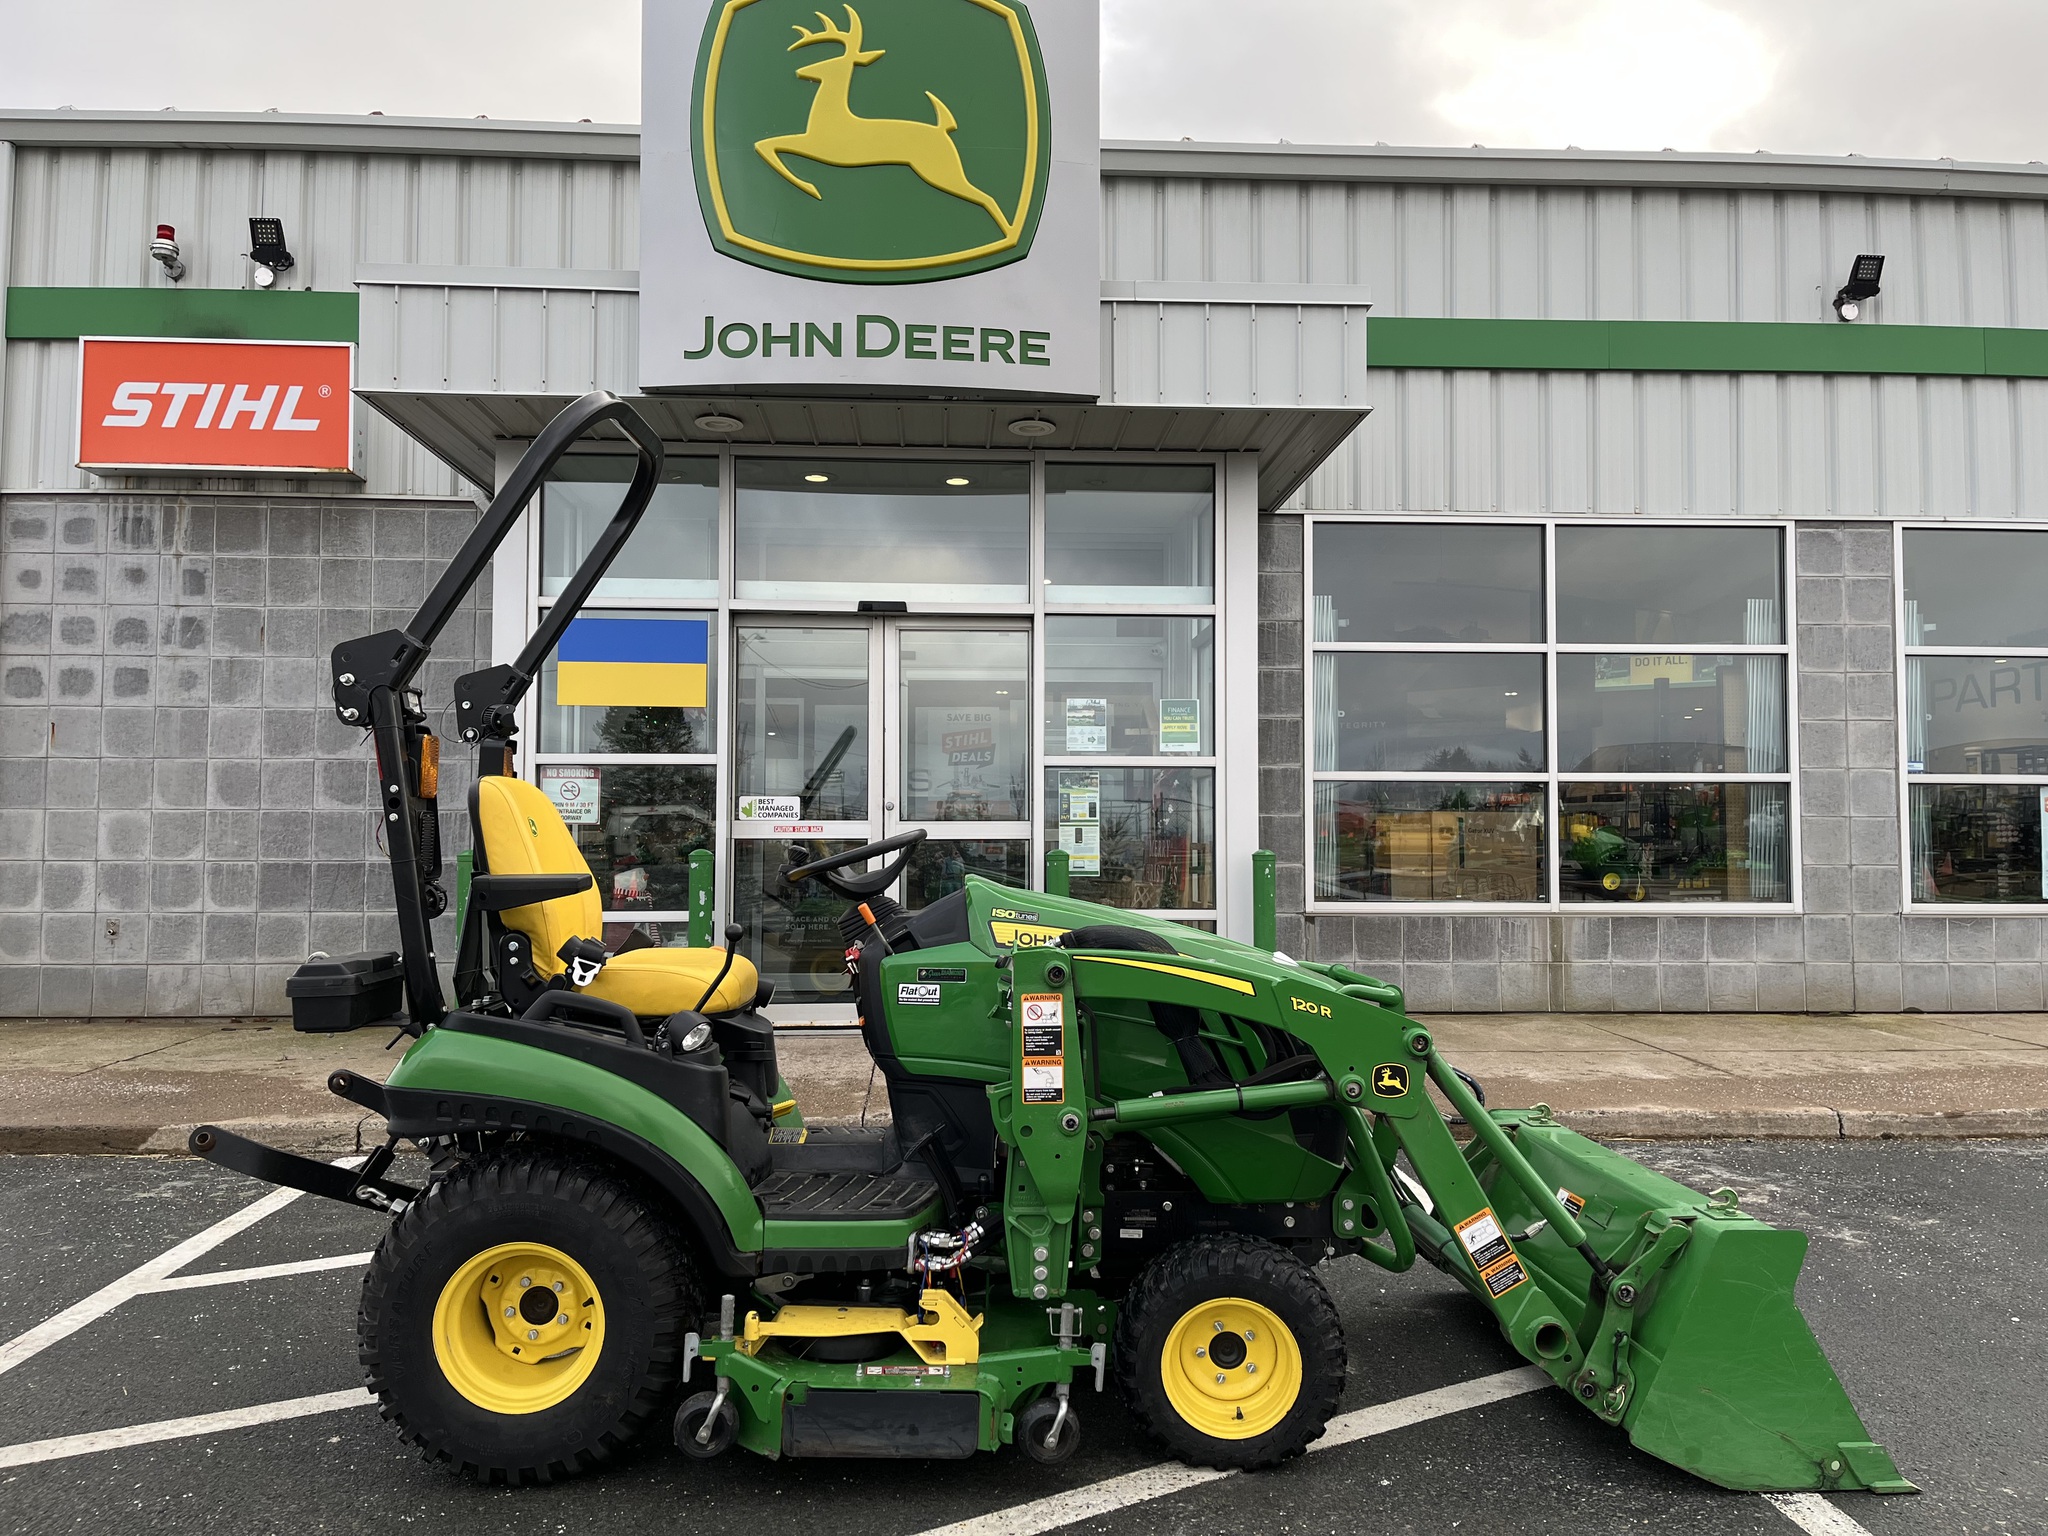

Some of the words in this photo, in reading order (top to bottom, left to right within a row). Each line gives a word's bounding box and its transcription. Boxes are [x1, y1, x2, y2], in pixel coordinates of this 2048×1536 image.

[683, 314, 843, 360] JOHN
[855, 314, 1051, 367] DEERE
[101, 381, 321, 432] STIHL
[1635, 657, 1650, 667] DO
[1653, 656, 1662, 666] IT
[1664, 655, 1688, 666] ALL.
[946, 713, 972, 722] SAVE
[974, 713, 992, 722] BIG
[1340, 721, 1386, 729] TEGRITY
[945, 731, 988, 749] STIHL
[951, 751, 992, 763] DEALS
[546, 768, 557, 777] NO
[558, 768, 595, 777] SMOKING
[1463, 1211, 1487, 1227] WARNING
[1490, 1258, 1514, 1274] WARNING
